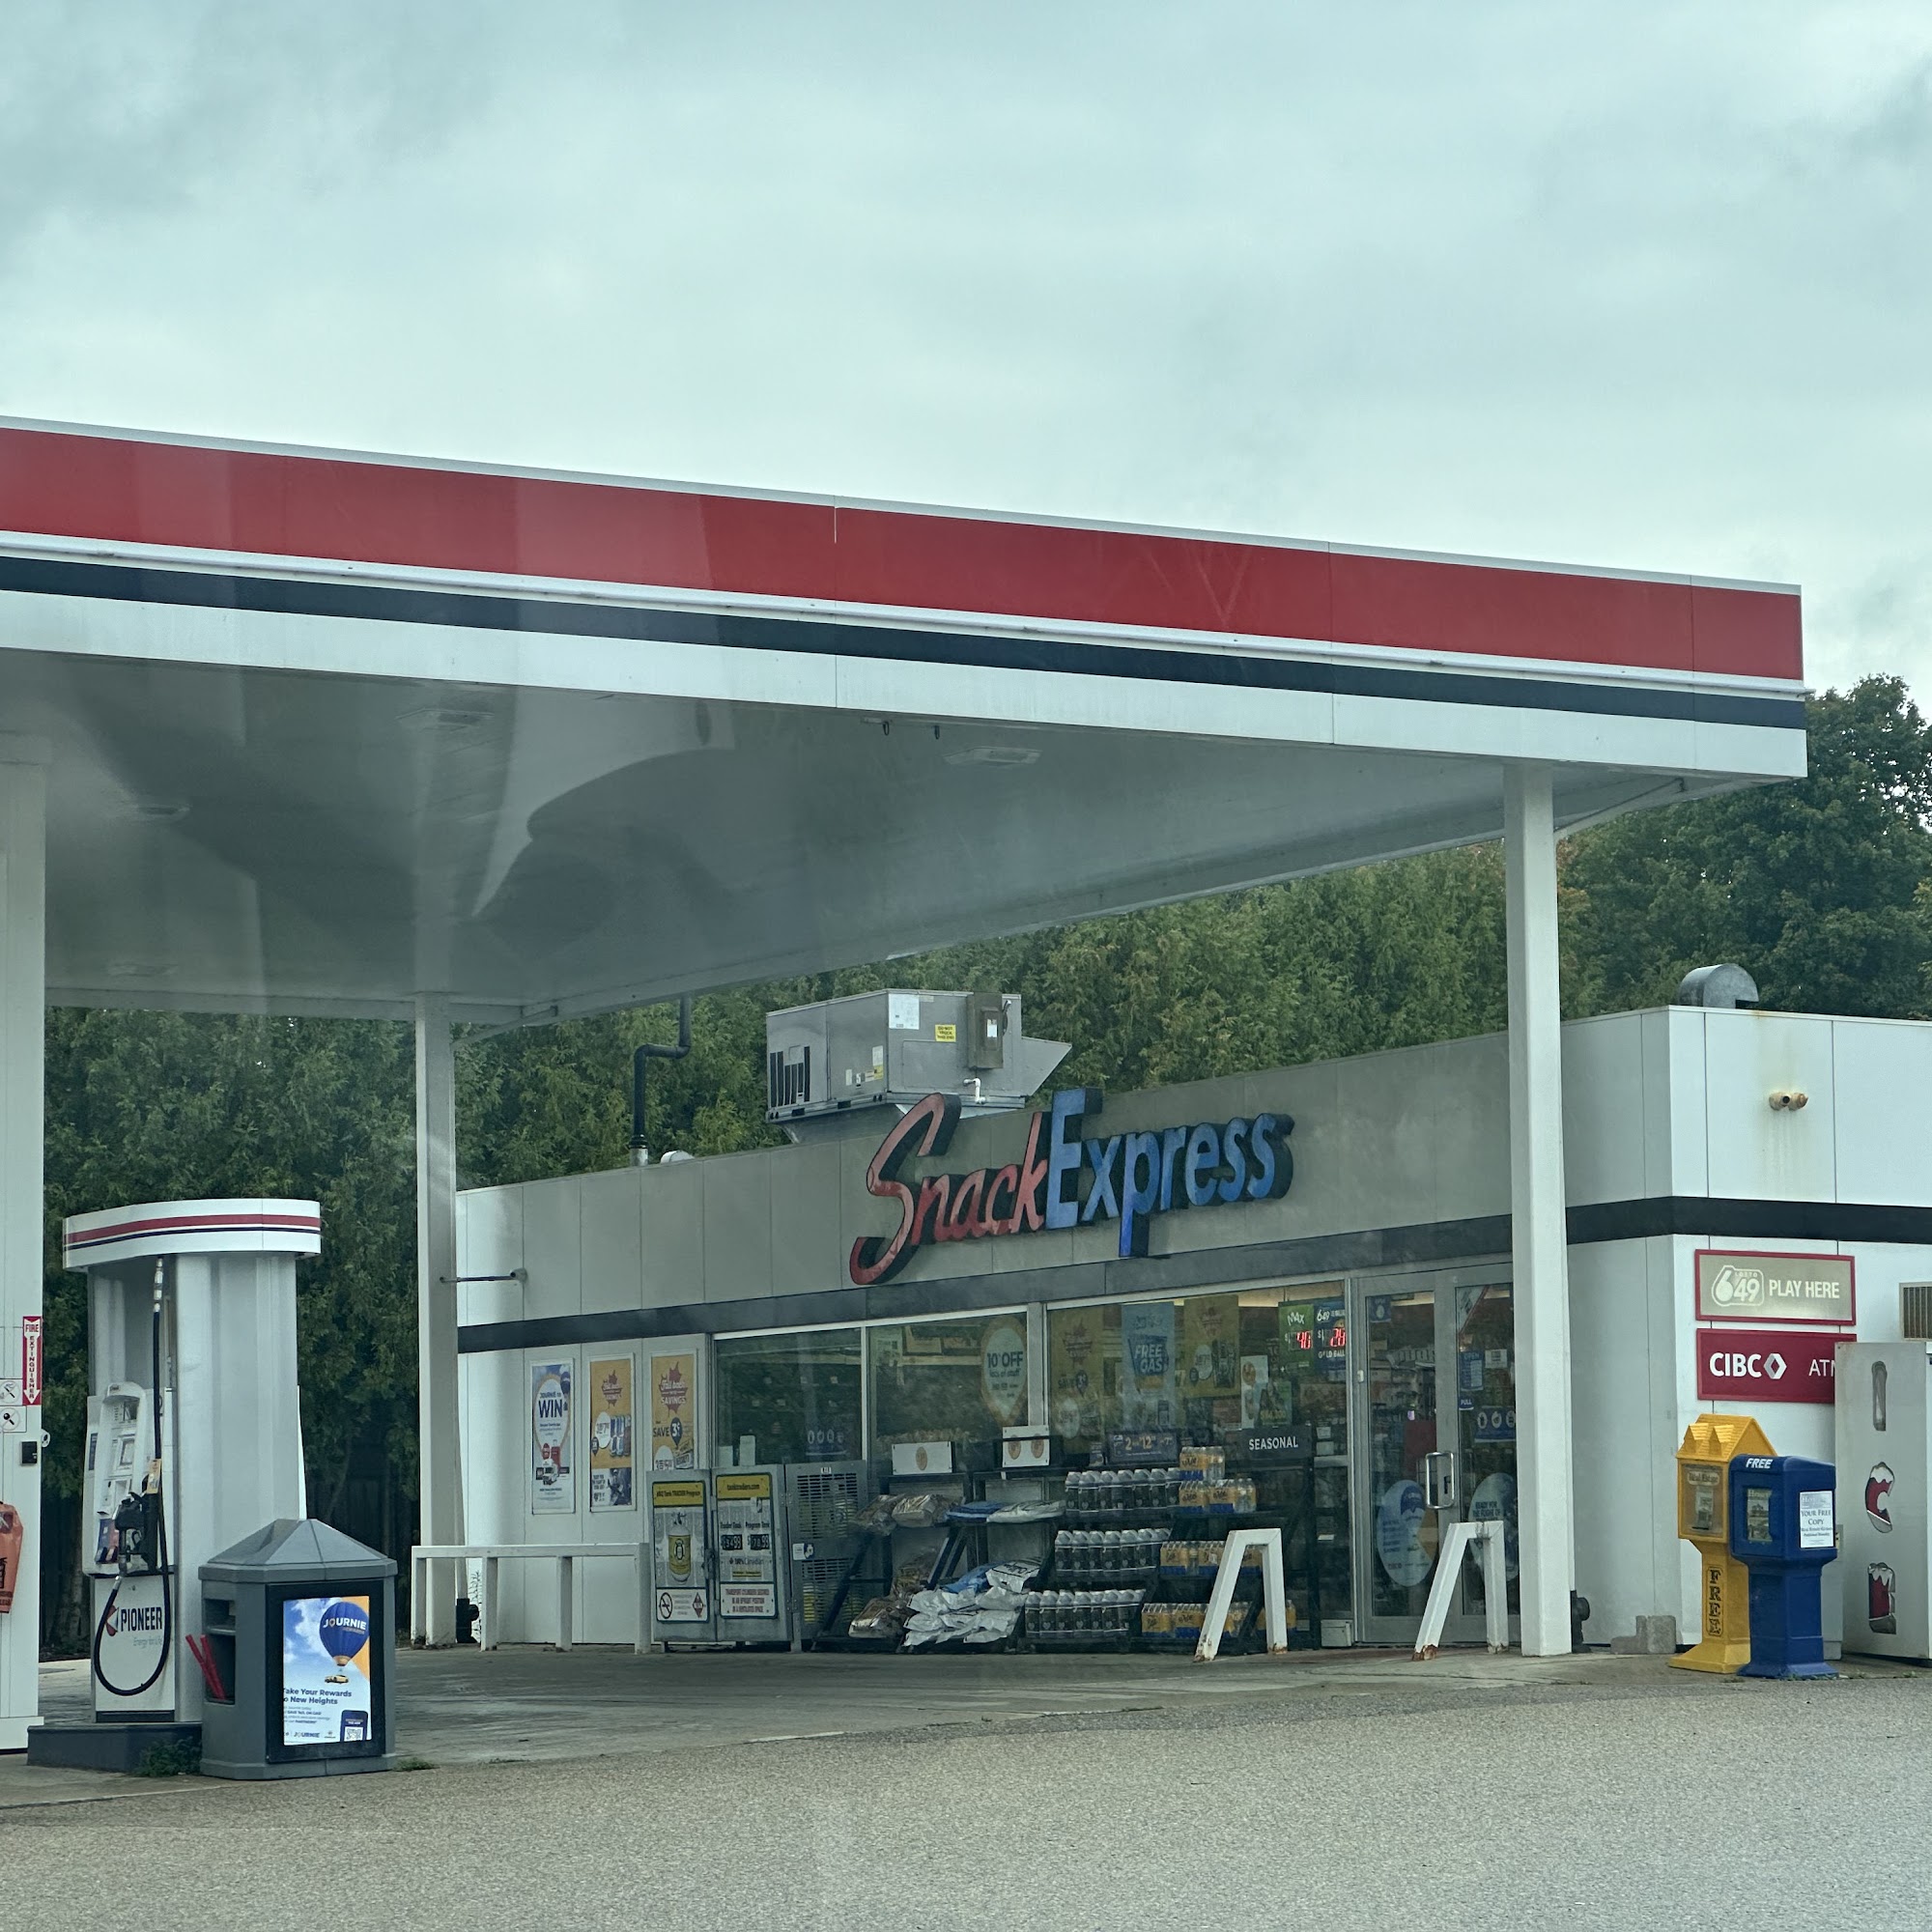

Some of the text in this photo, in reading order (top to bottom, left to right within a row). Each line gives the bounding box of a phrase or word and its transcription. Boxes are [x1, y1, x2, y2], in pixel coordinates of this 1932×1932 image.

[1769, 1279, 1802, 1297] PLAY
[1805, 1281, 1840, 1298] HERE
[25, 1323, 40, 1333] FIRE
[1002, 1350, 1023, 1368] OFF
[1135, 1344, 1163, 1360] FREE
[1140, 1358, 1163, 1373] GAS
[1709, 1352, 1762, 1378] CIBC
[538, 1399, 563, 1418] WIN
[653, 1427, 670, 1437] SAVE
[1249, 1435, 1299, 1451] SEASONAL
[1746, 1457, 1774, 1469] FREE
[1709, 1569, 1721, 1634] FREE
[121, 1606, 162, 1632] PIONEER
[323, 1617, 367, 1631] JOURNIE
[320, 1689, 352, 1697] Rewards
